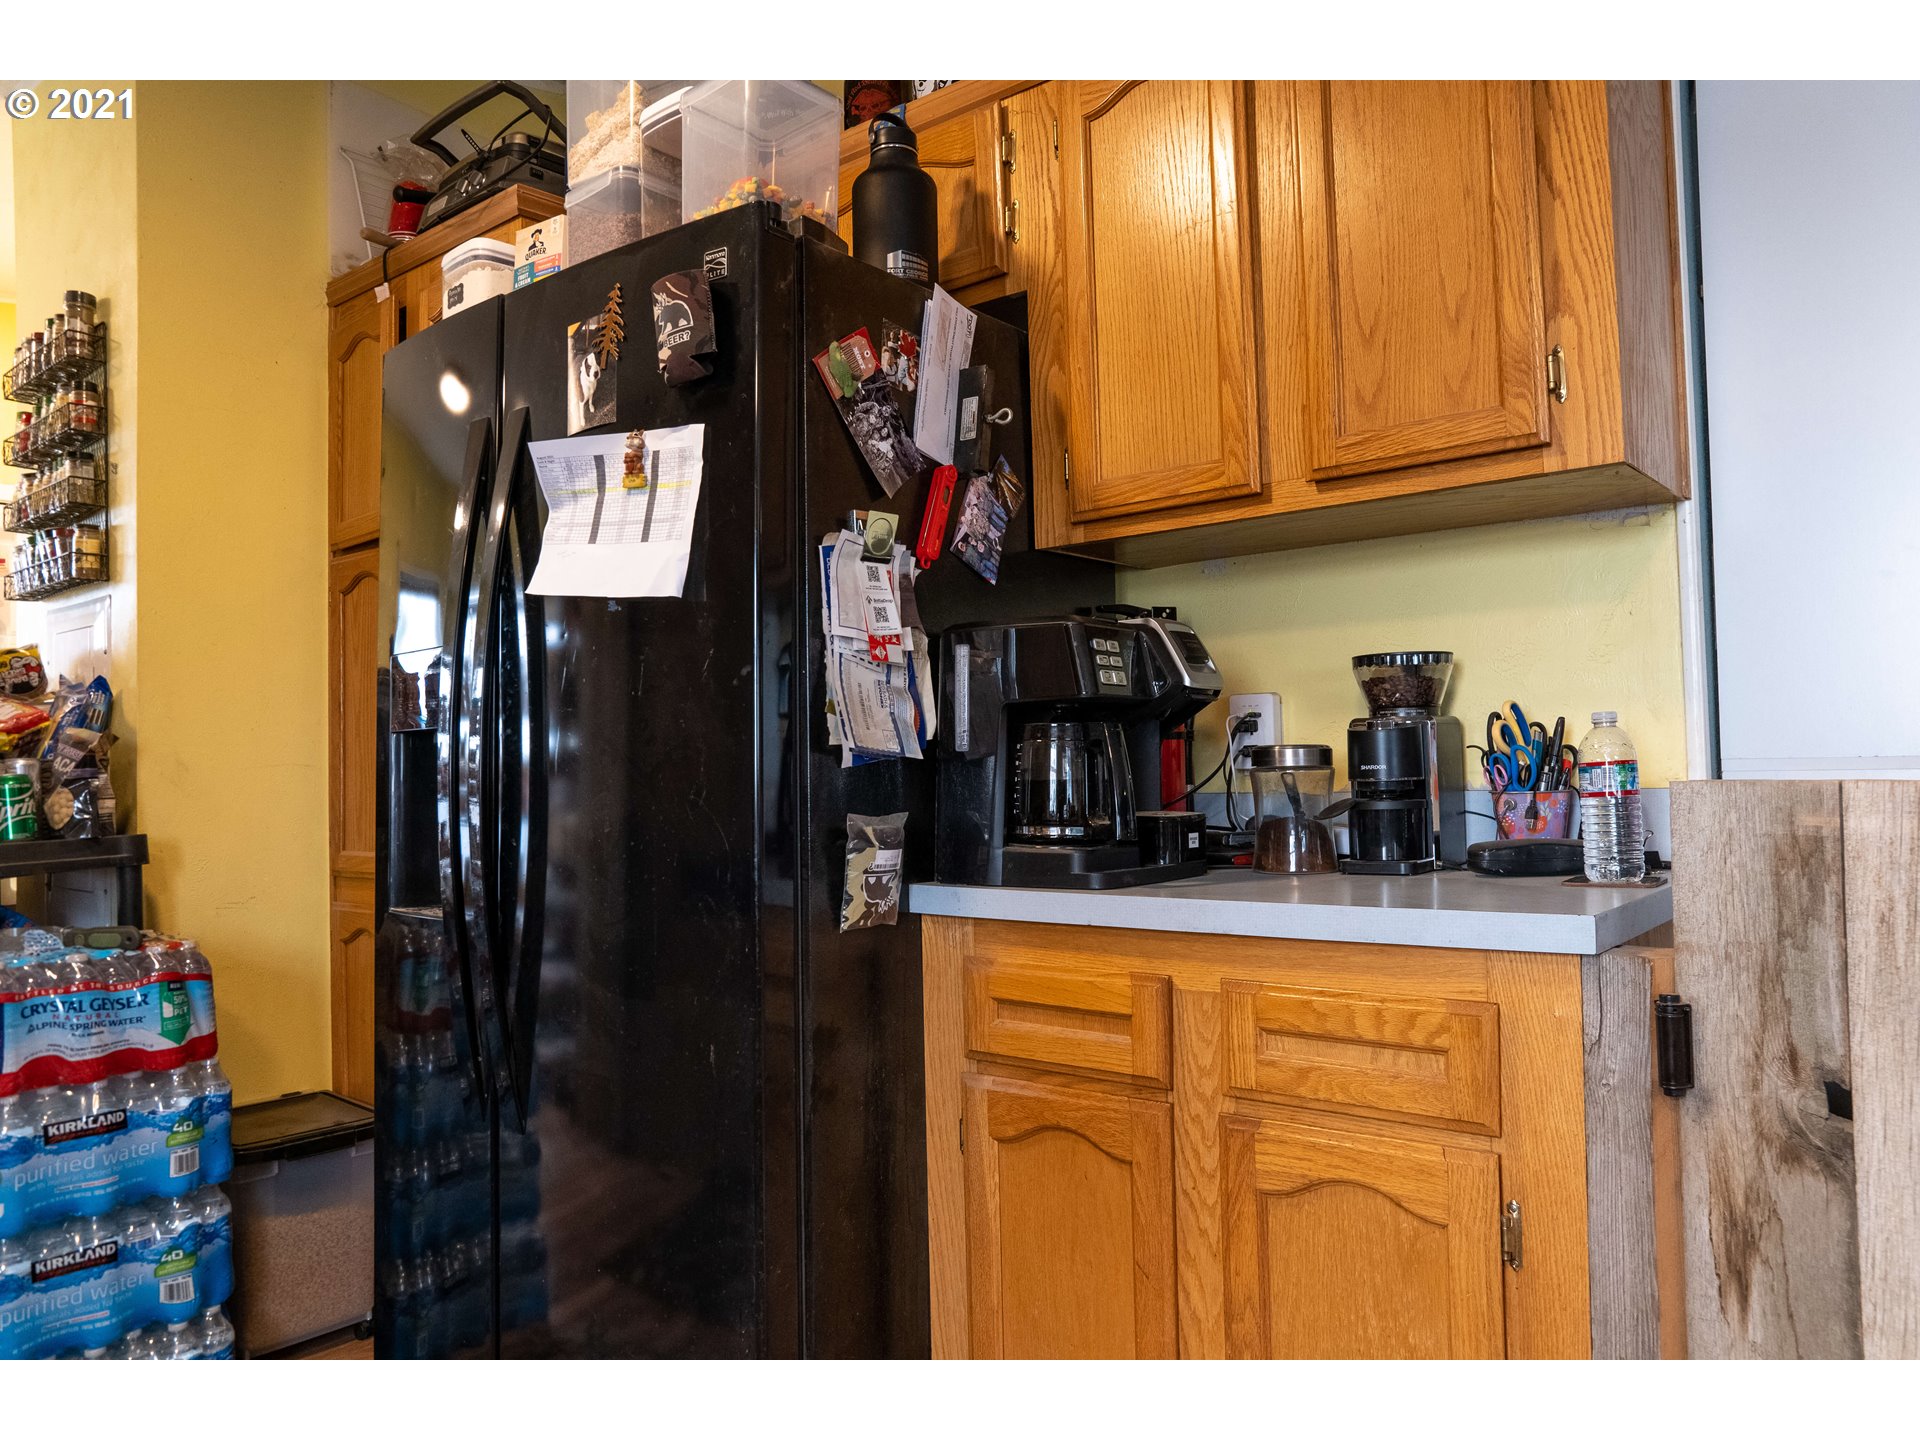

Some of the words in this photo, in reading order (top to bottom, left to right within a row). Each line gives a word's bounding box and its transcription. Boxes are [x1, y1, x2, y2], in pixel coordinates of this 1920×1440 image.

[525, 247, 547, 261] QUAKER
[663, 330, 691, 348] BEER?
[108, 976, 158, 991] SOURCE
[20, 999, 87, 1019] CRYSTAL
[89, 993, 149, 1012] GEYSER
[27, 1021, 69, 1034] ALPINE
[69, 1020, 107, 1031] SPRING
[108, 1015, 144, 1027] WATER
[48, 1111, 125, 1137] KIRKLAND
[172, 1121, 193, 1133] 40
[14, 1152, 96, 1191] purified
[103, 1141, 158, 1164] water
[34, 1243, 116, 1274] KIRKLAND
[161, 1249, 183, 1263] 40
[0, 1287, 83, 1331] purified
[90, 1273, 144, 1299] water
